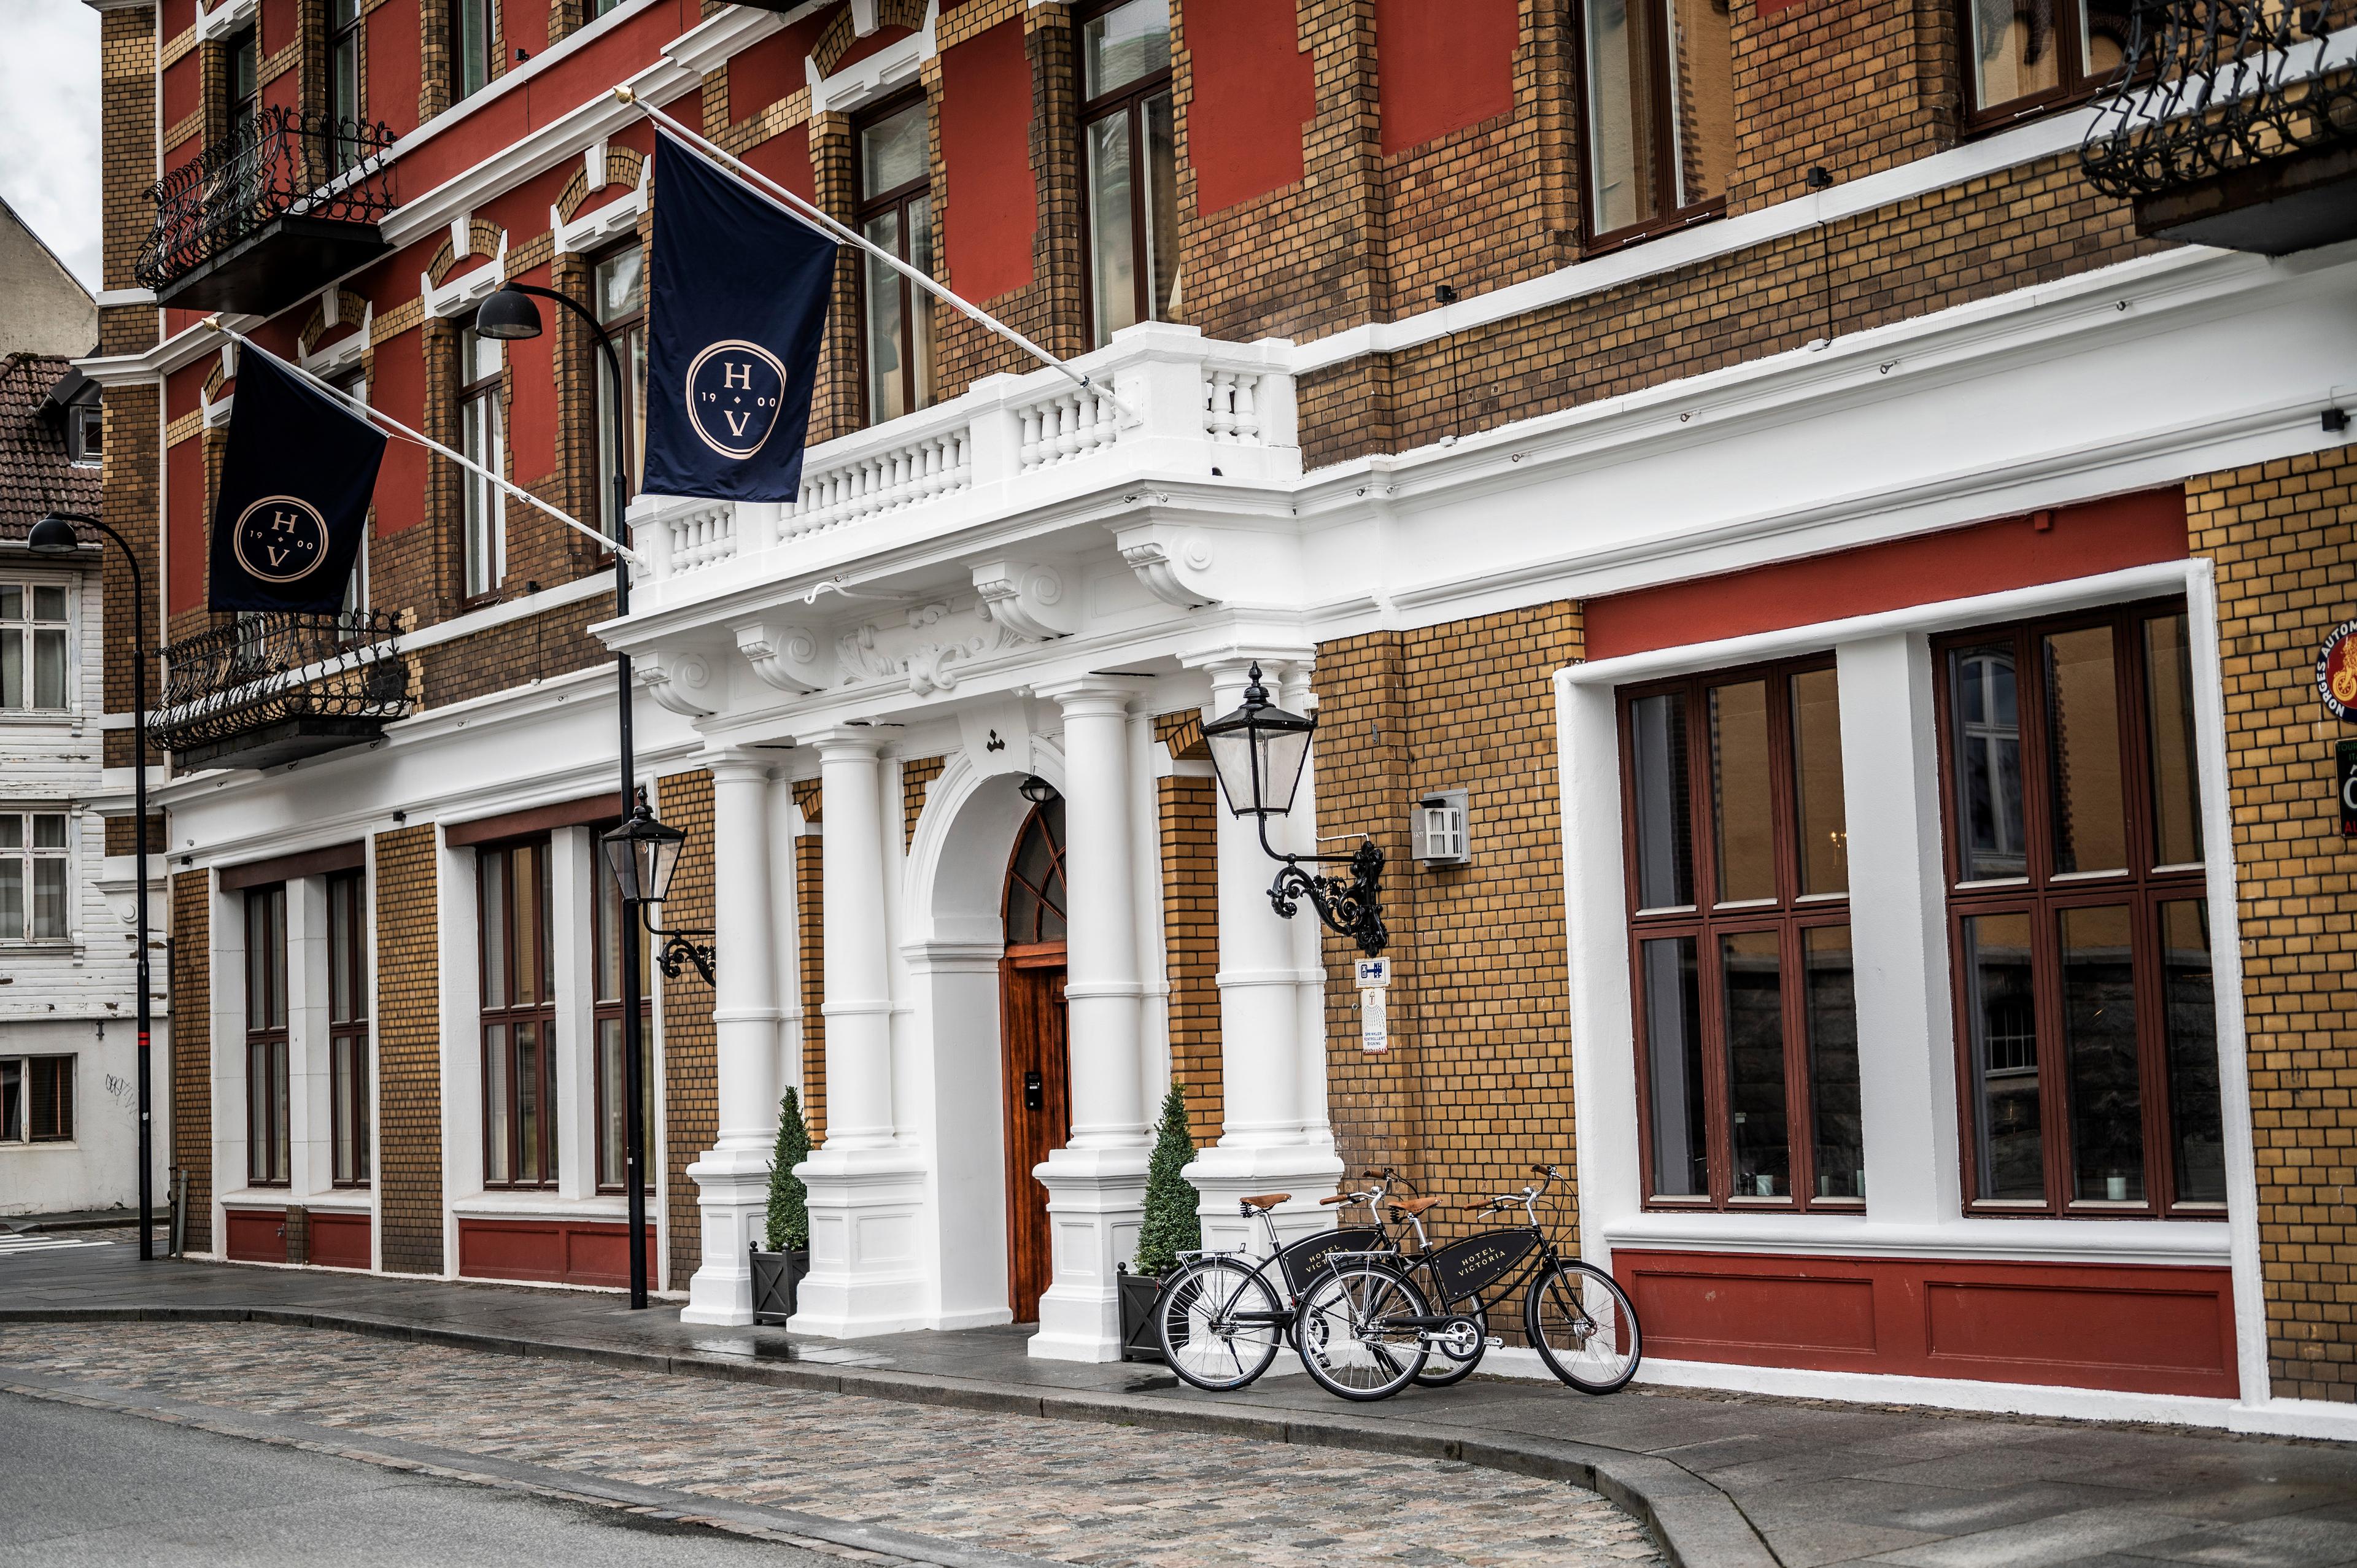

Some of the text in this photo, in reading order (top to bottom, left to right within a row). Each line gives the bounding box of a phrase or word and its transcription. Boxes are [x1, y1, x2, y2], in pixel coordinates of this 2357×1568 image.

[724, 362, 752, 390] H
[702, 392, 776, 407] 19 00
[724, 410, 751, 436] V
[271, 511, 298, 534] H
[267, 545, 290, 567] V
[2316, 661, 2345, 717] NORGES
[1309, 1245, 1340, 1262] HOTEL
[1458, 1251, 1506, 1276] VICTORIA
[1461, 1247, 1495, 1265] HOTEL
